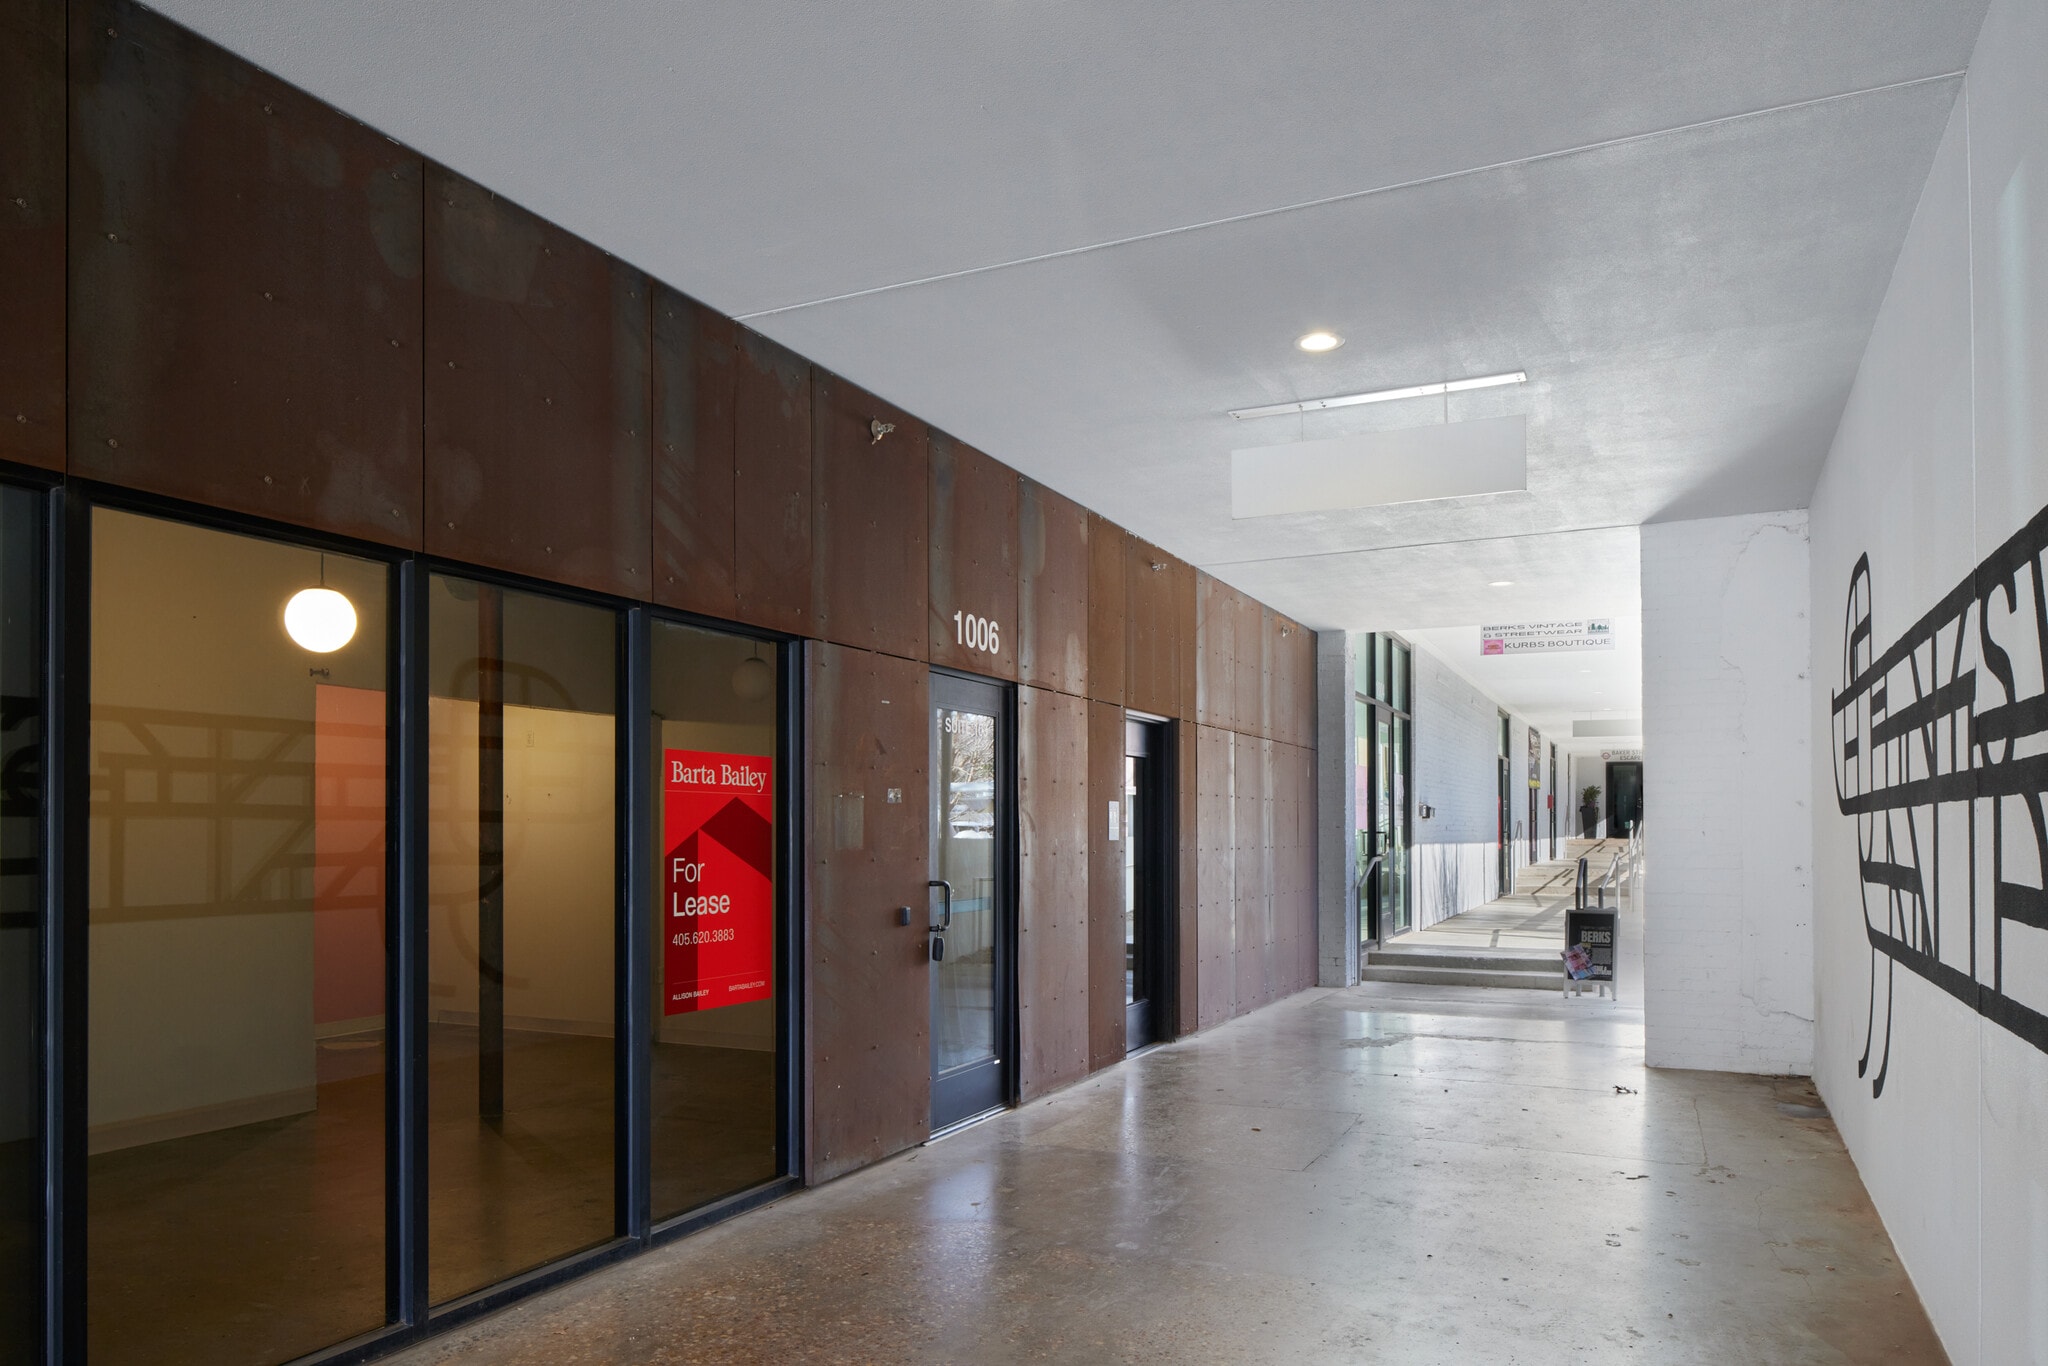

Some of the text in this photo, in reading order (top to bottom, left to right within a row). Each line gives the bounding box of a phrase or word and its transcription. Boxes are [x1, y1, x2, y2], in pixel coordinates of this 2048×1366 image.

[953, 610, 1000, 655] 1006
[1482, 622, 1583, 632] BERKS VINTAGE
[1494, 629, 1583, 638] STREETWEAR
[1504, 641, 1546, 649] KURBS
[1547, 638, 1612, 648] BOUTIQUE
[945, 717, 972, 735] SUITE
[671, 760, 767, 793] Barta Bailey
[673, 857, 705, 883] For
[673, 892, 731, 917] Lease
[672, 928, 735, 946] 405.620.3883
[1581, 930, 1612, 944] BERKS
[672, 980, 766, 1001] ALLISON BAILEY BARTABAILEY.COM
